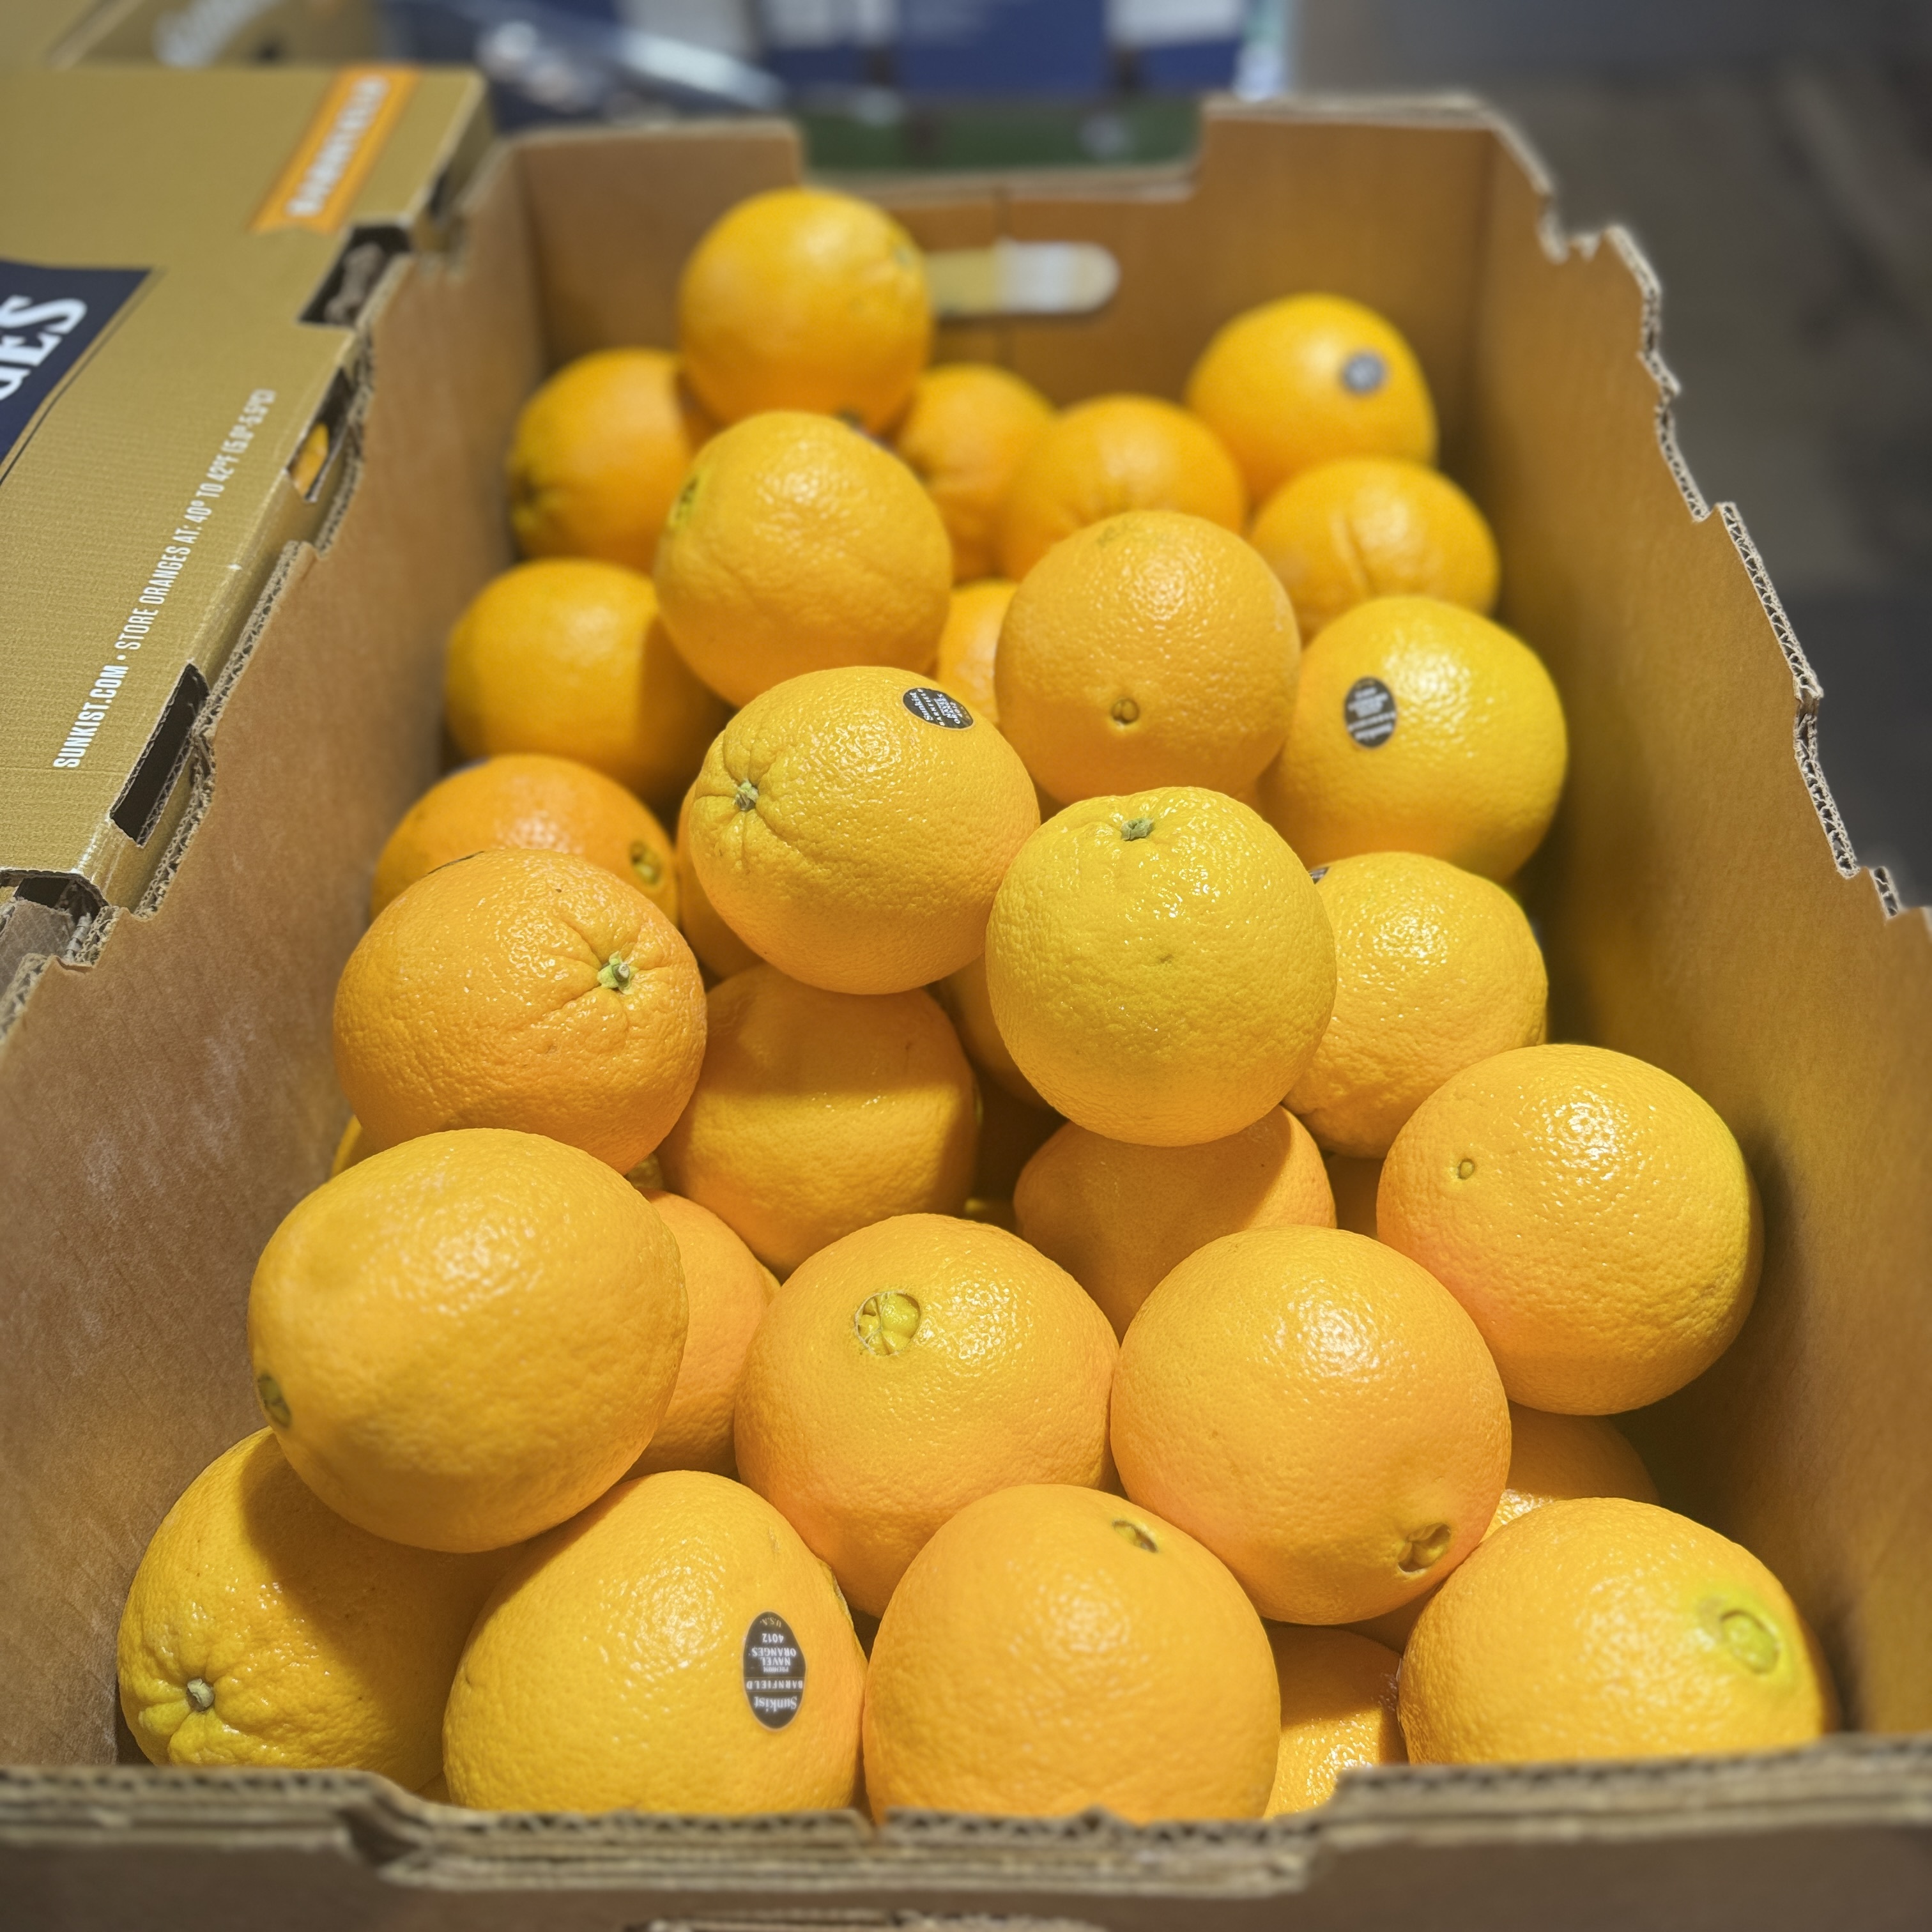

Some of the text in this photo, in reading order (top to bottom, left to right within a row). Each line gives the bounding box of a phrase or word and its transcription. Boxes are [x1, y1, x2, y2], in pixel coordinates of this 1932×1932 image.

[52, 665, 129, 768] SUNKIST.COM
[114, 608, 159, 650] STORE
[139, 546, 191, 605] ORANGES
[172, 525, 203, 544] AT:
[195, 482, 225, 498] TO
[909, 692, 933, 721] Sunkist
[917, 688, 946, 726] BARNFIELD
[762, 1633, 784, 1643] 4012
[751, 1647, 797, 1657] ORANGES
[761, 1657, 791, 1666] NAVEL
[746, 1680, 803, 1690] BARNFIELD
[754, 1696, 798, 1712] Sunkist
